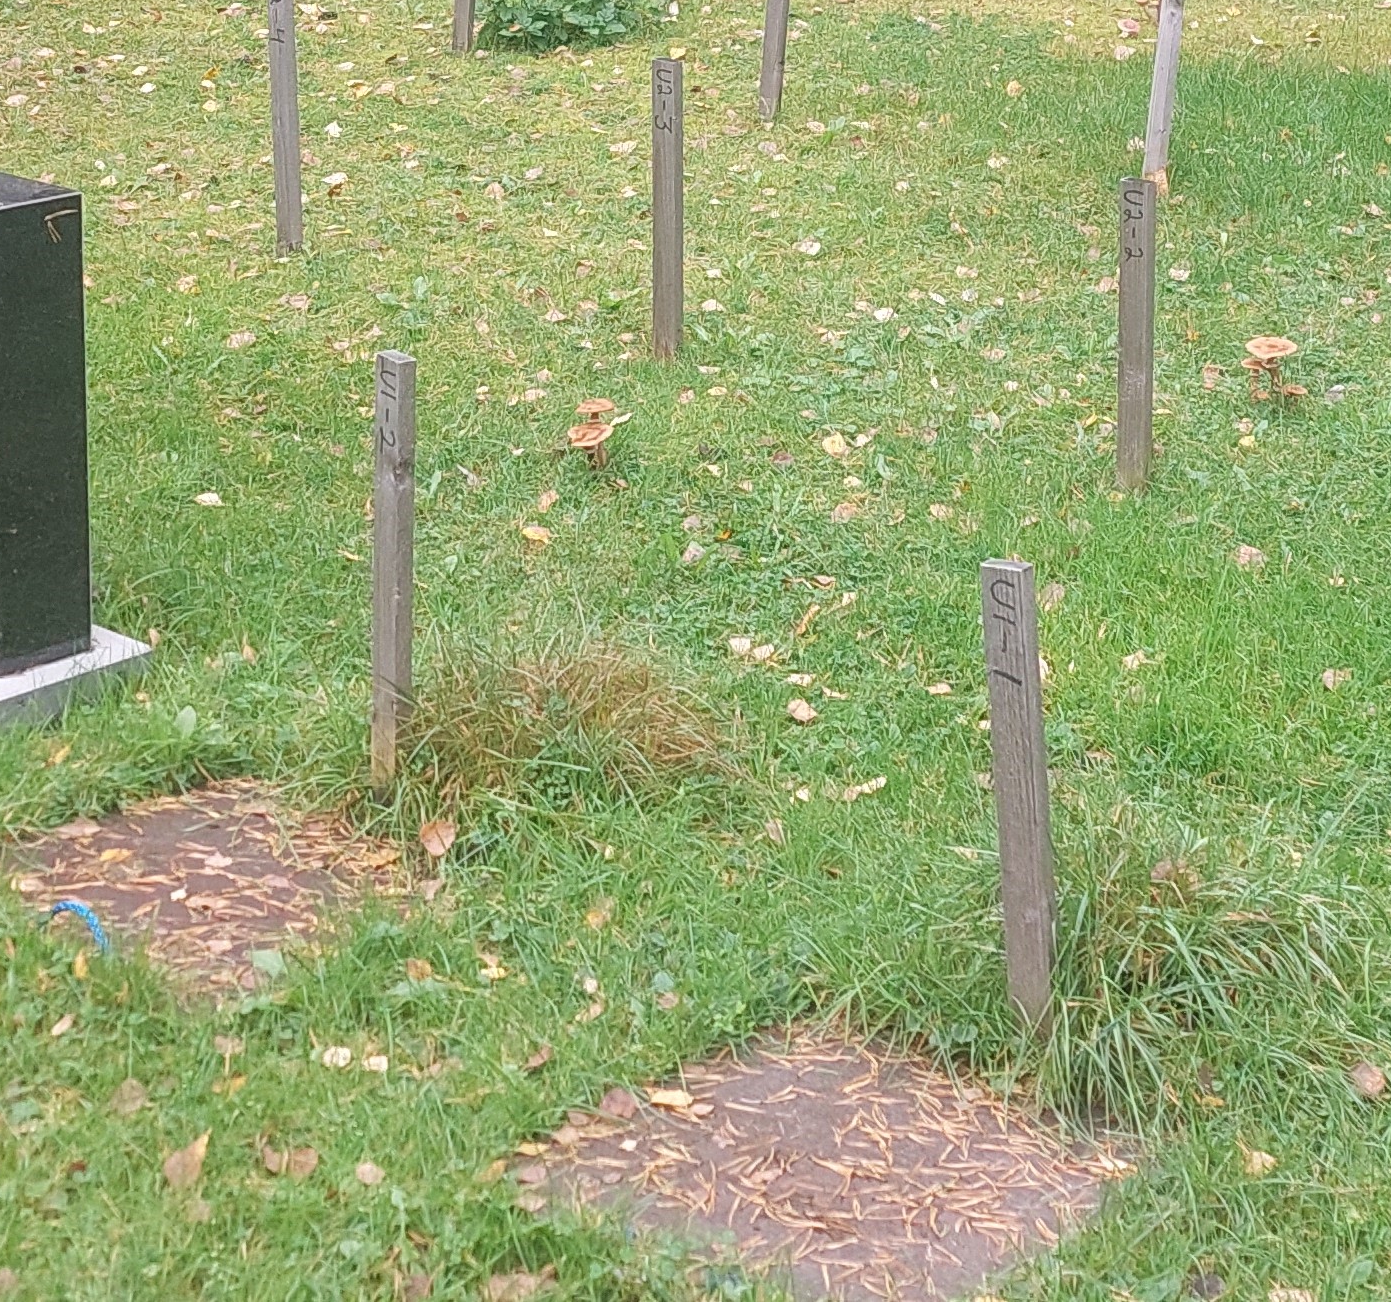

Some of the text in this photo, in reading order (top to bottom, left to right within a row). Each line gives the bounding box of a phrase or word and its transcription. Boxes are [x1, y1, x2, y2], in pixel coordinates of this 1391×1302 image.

[654, 68, 673, 134] U2-3
[1123, 189, 1144, 262] U2-2
[989, 578, 1024, 687] U1-1
